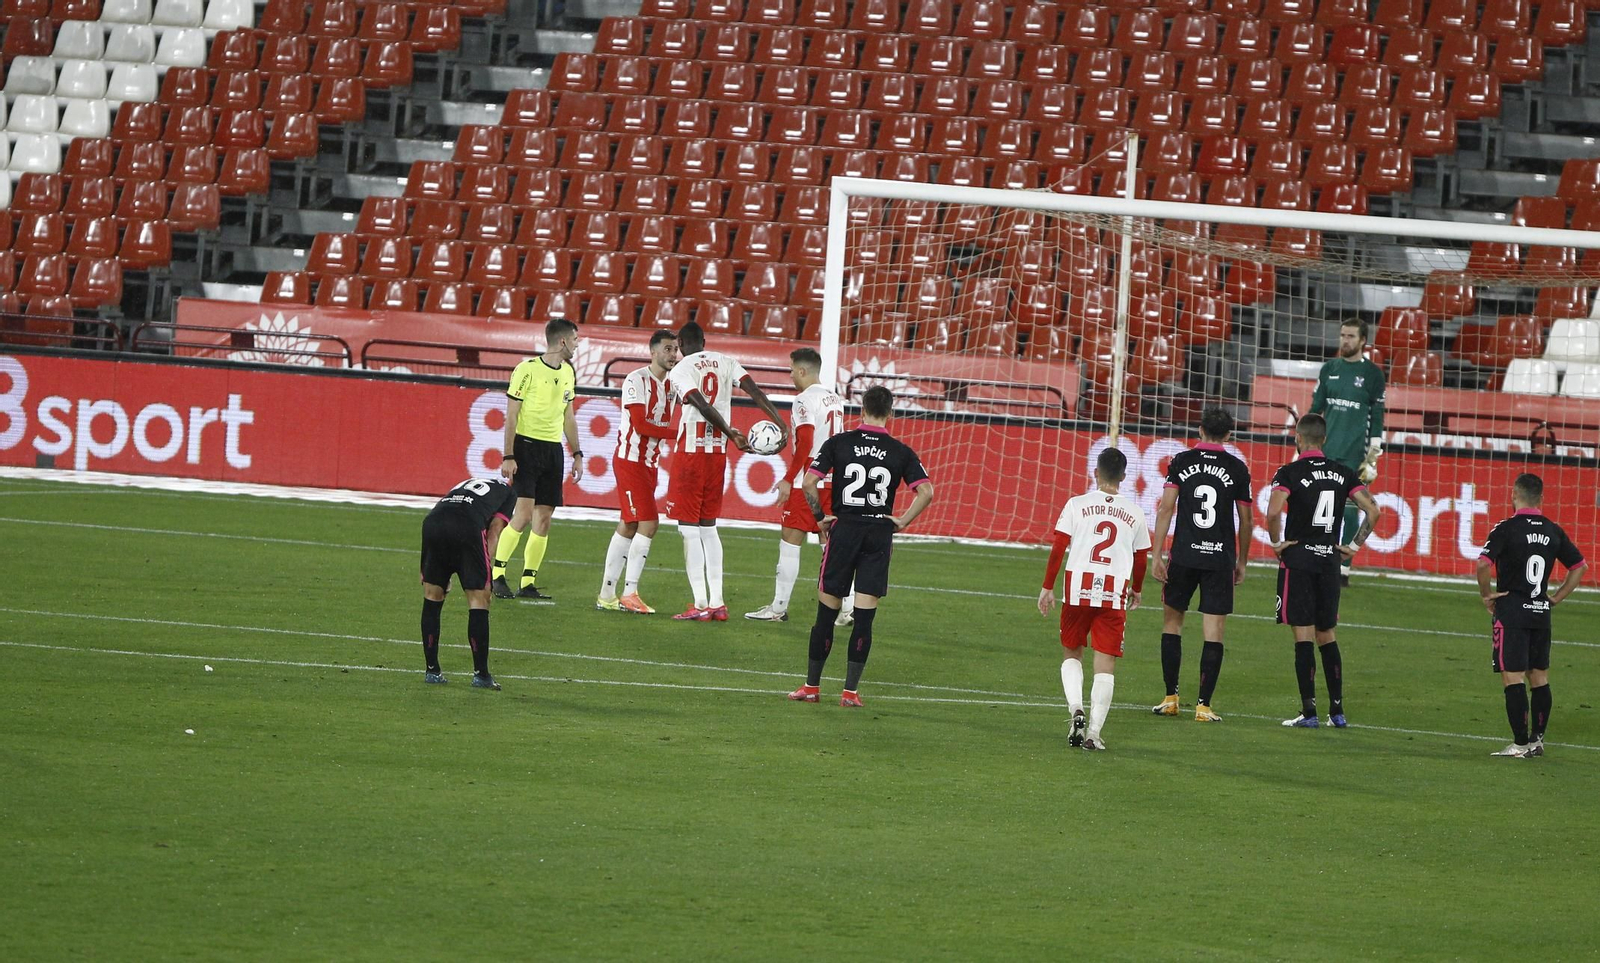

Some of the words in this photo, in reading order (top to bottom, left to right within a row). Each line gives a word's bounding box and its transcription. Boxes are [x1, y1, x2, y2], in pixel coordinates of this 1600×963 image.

[702, 371, 719, 406] 9
[854, 445, 887, 460] ŠIPČIĆ
[842, 462, 892, 507] 23
[1178, 463, 1201, 482] ALEX
[1203, 463, 1234, 488] MUÑOZ
[1301, 478, 1313, 488] B.
[1312, 470, 1345, 486] WILSON
[1082, 505, 1105, 518] AITOR
[1107, 507, 1136, 529] BUÑUEL
[1192, 484, 1217, 529] 3
[1312, 490, 1335, 534] 4
[1089, 520, 1118, 566] 2
[1526, 533, 1550, 546] NONO
[1526, 554, 1546, 598] 9
